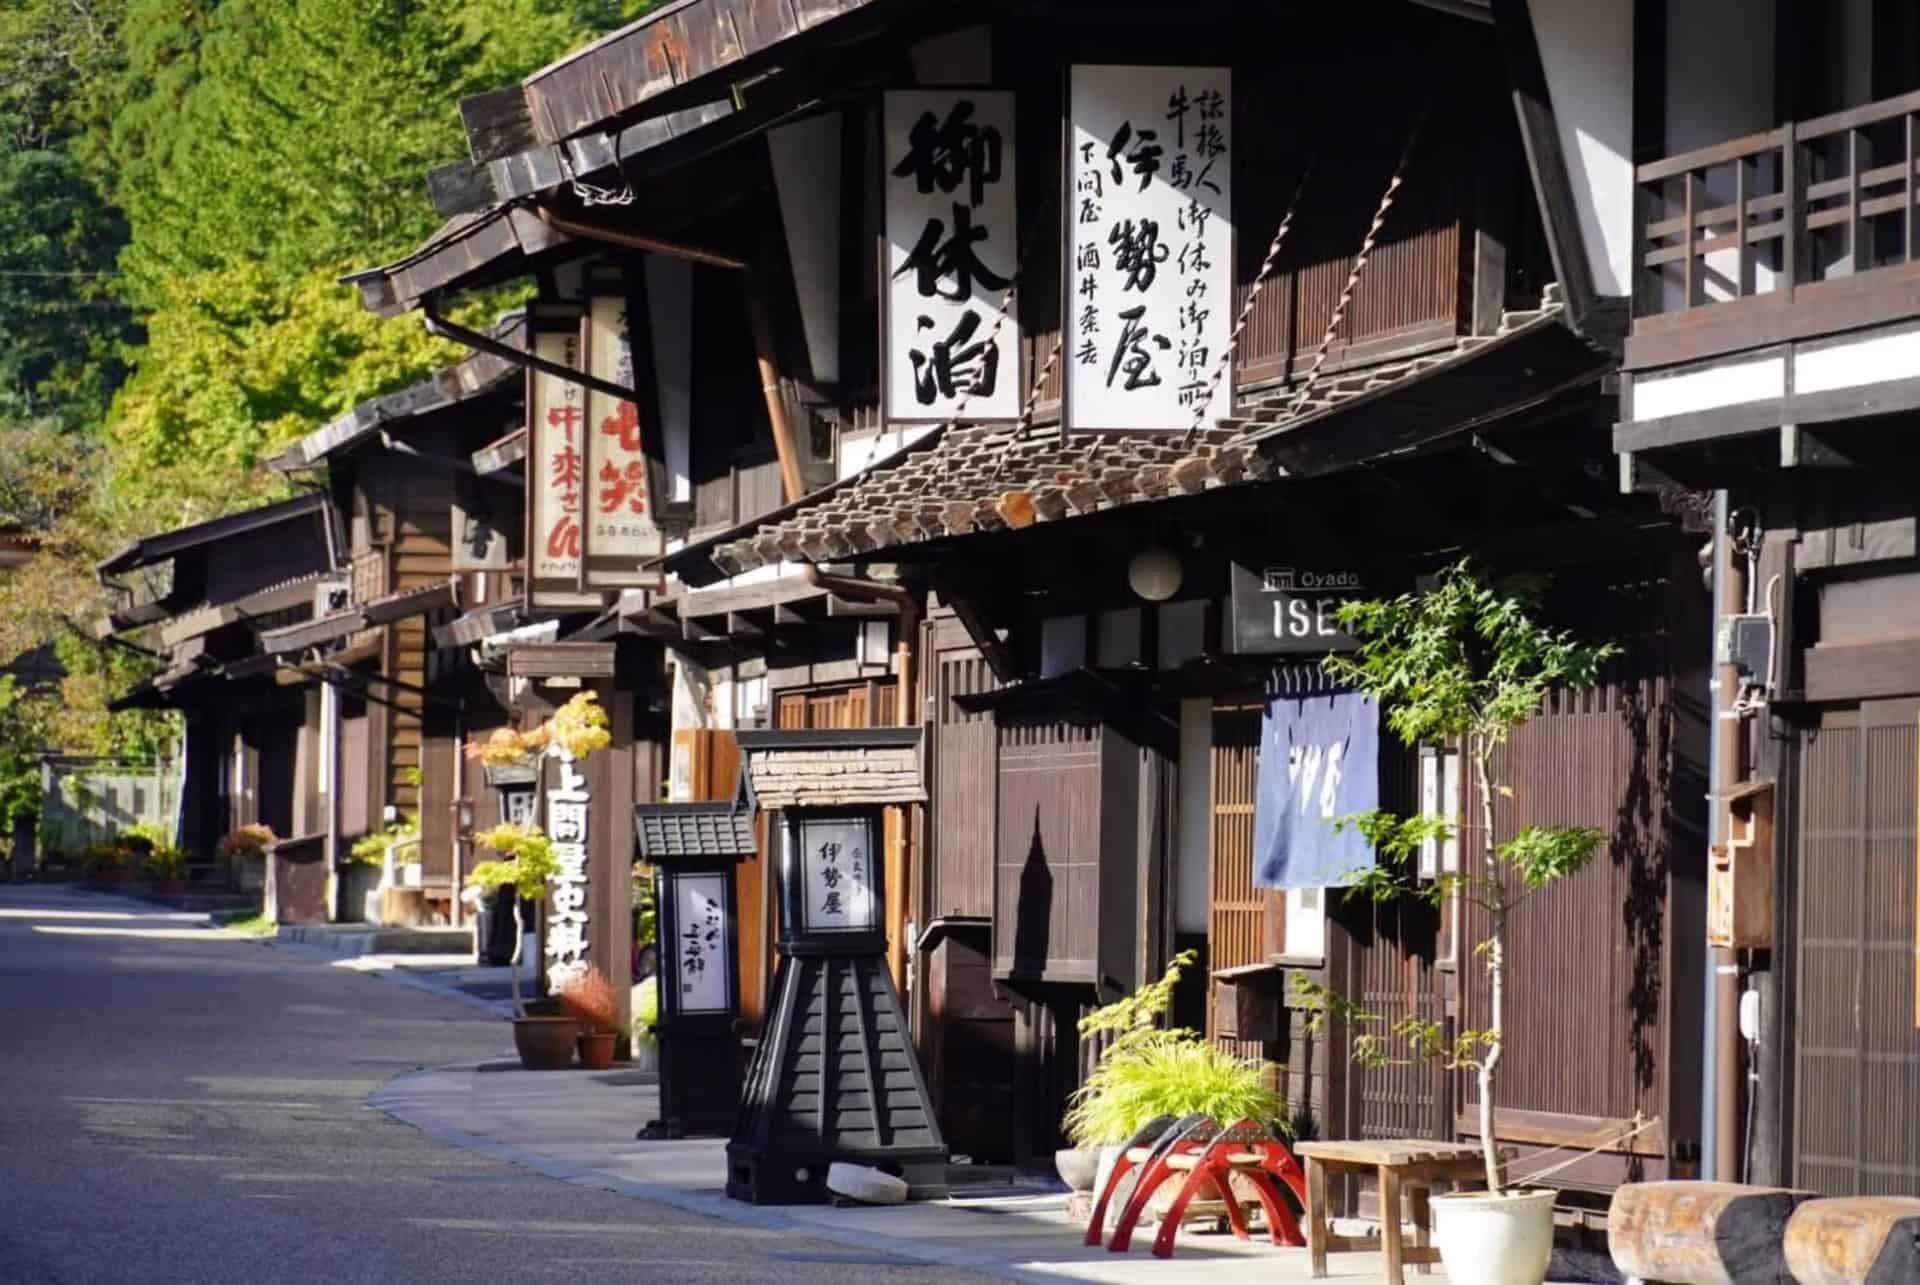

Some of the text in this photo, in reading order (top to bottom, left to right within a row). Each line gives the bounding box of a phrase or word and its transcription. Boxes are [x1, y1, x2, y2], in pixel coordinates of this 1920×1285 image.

[890, 99, 1022, 406] 御休泊
[1106, 119, 1171, 392] 伊勢屋
[1301, 571, 1359, 587] Oyado
[818, 841, 843, 915] 伊勢屋
